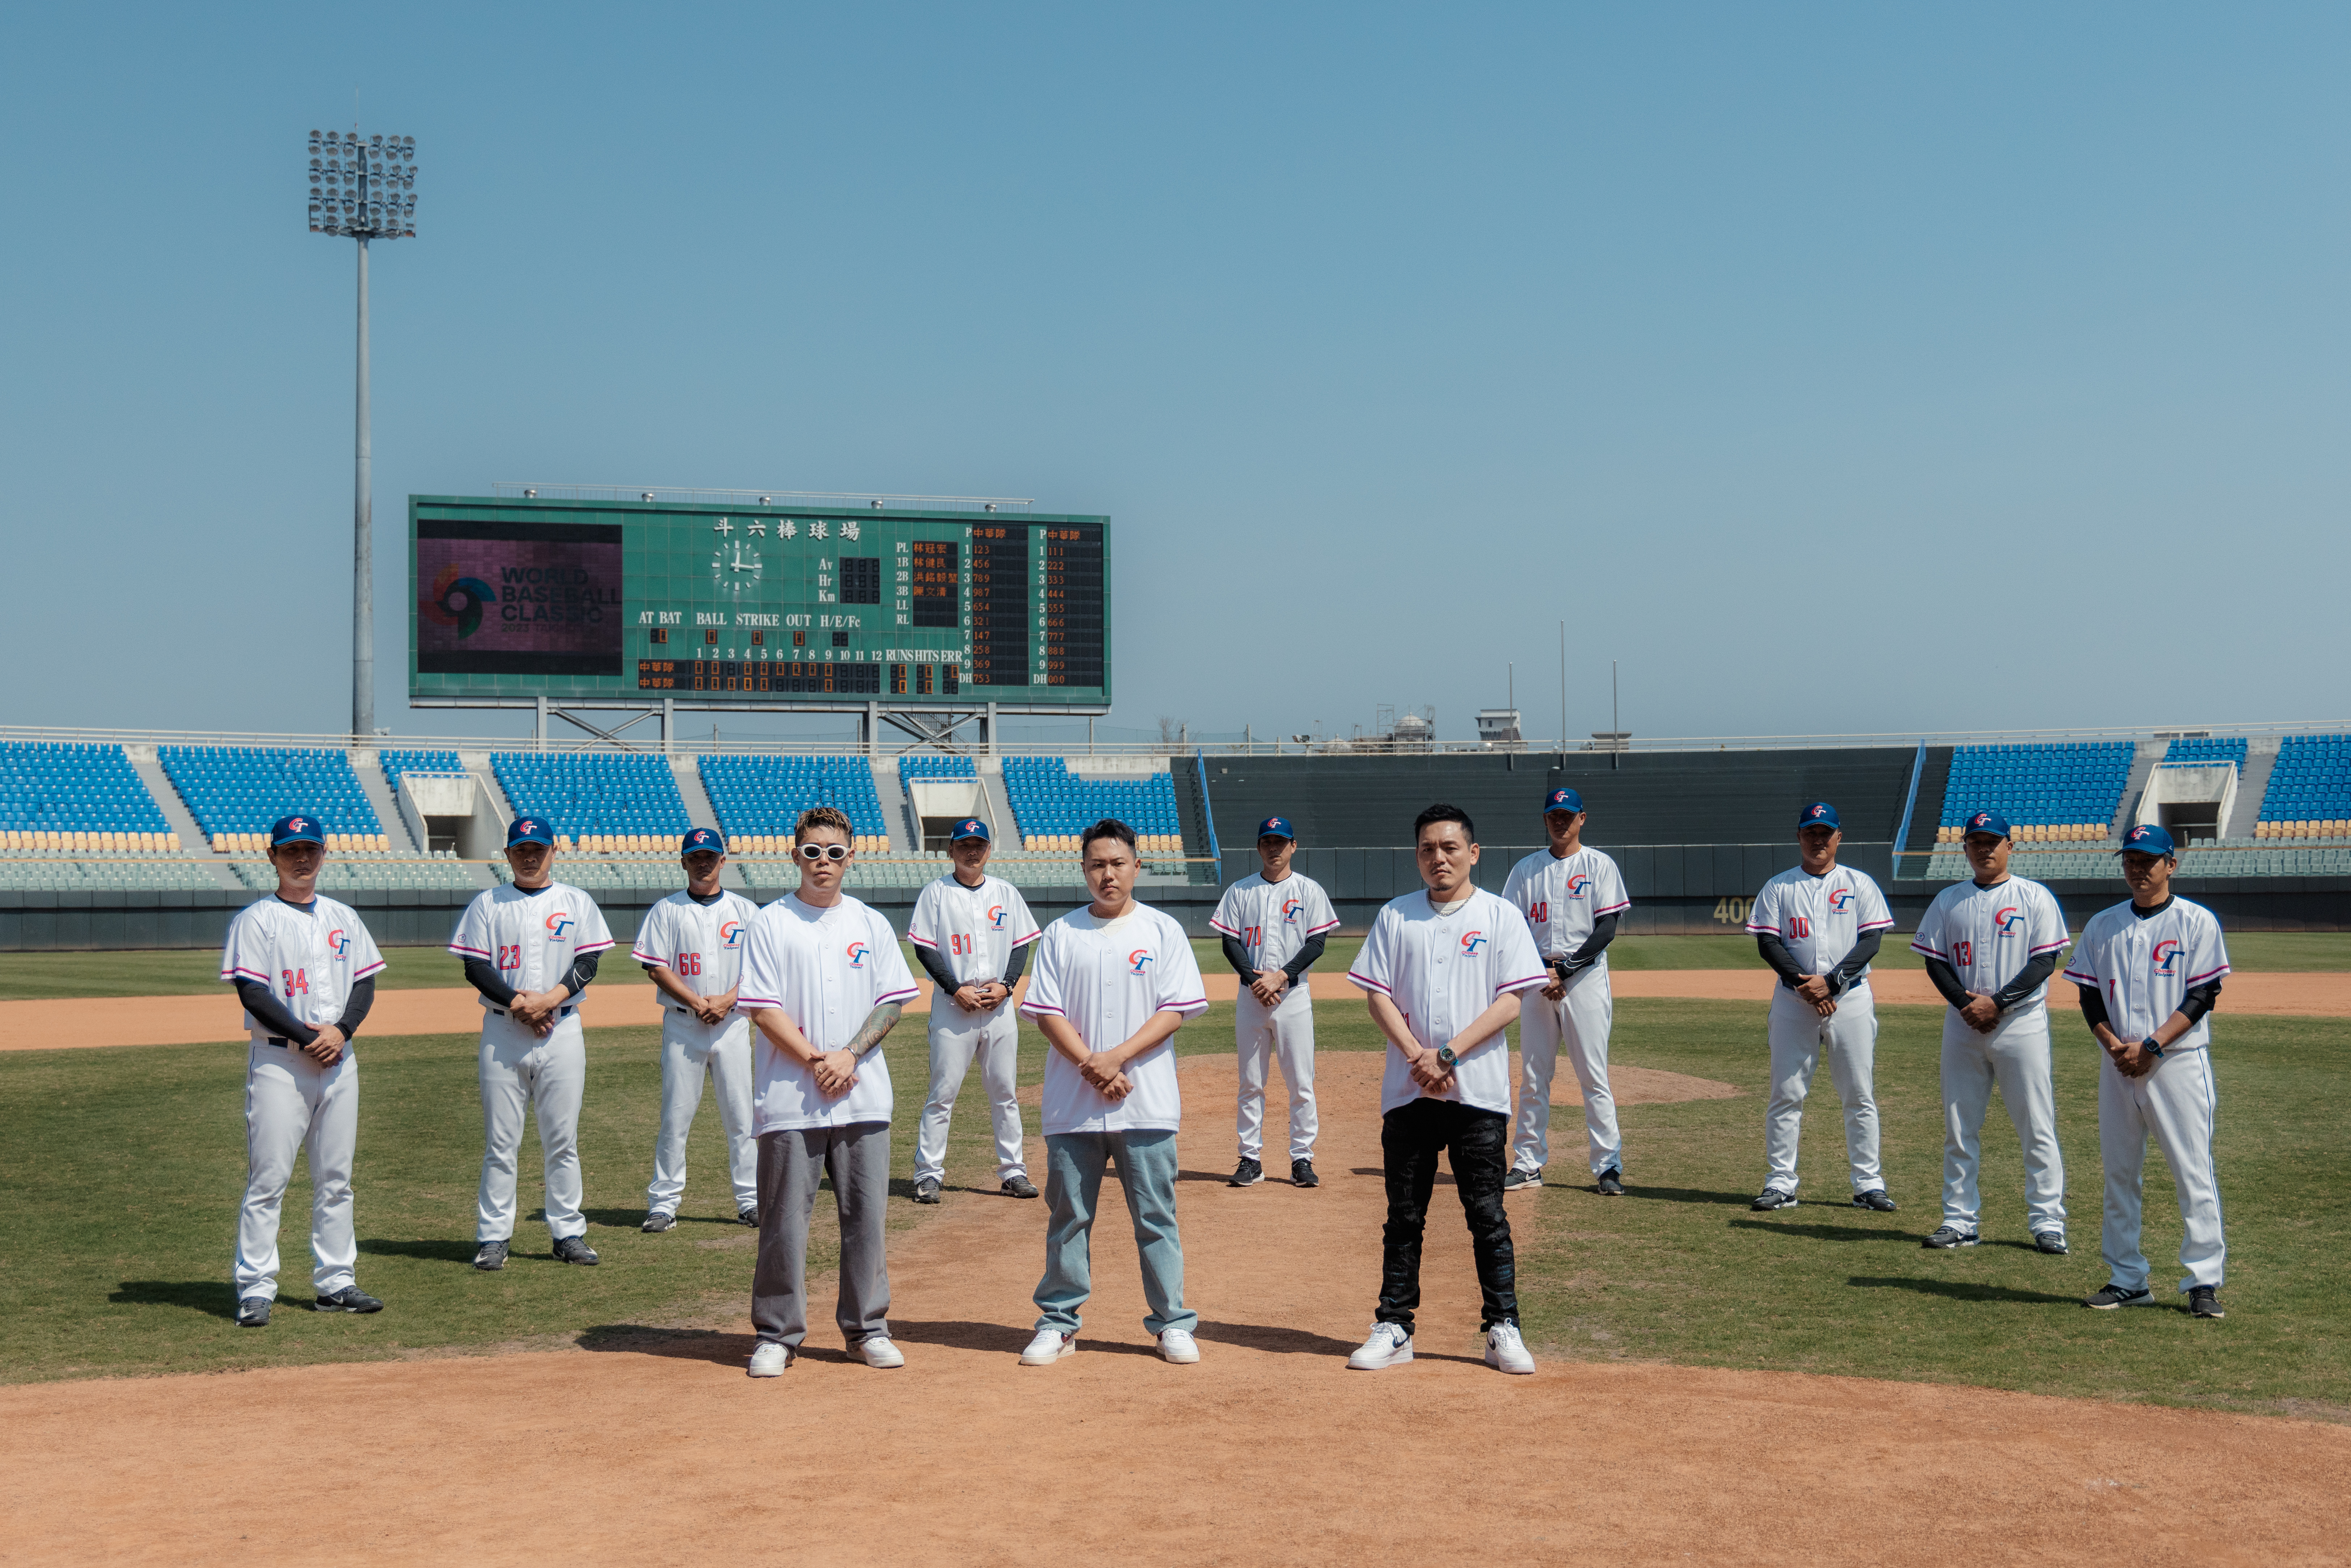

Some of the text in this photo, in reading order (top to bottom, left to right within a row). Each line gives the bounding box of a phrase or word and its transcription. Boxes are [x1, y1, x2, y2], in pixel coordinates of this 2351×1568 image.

[714, 517, 860, 541] 斗六棒球場
[965, 527, 972, 537] P
[973, 528, 1006, 539] 中華隊
[1039, 529, 1046, 539] P
[1048, 530, 1080, 541] 中華隊
[897, 542, 908, 553] PL
[965, 544, 969, 554] 1
[1039, 546, 1044, 556] 1
[818, 558, 833, 570] Av
[897, 557, 908, 567] 1B
[964, 558, 970, 568] 2
[1038, 560, 1045, 570] 2
[501, 567, 589, 584] WORLD
[818, 574, 832, 586] Hr
[897, 571, 908, 581] 2B
[964, 573, 970, 583] 3
[1039, 575, 1045, 584] 3
[502, 585, 622, 605] BASEBALL
[818, 590, 835, 602] Km
[897, 586, 908, 596] 3B
[963, 587, 970, 597] 4
[1038, 589, 1045, 598] 4
[897, 600, 908, 610] LL
[964, 601, 970, 611] 5
[1039, 603, 1045, 613] 5
[501, 604, 603, 623] CLASSIC
[639, 611, 682, 624] AT BAT
[696, 613, 727, 625] BALL
[736, 613, 780, 626] STRIKE
[897, 614, 909, 624] RL
[786, 614, 812, 627] OUT
[820, 615, 861, 627] H/E/Fc
[964, 616, 970, 626] 6
[1039, 617, 1045, 627] 6
[659, 629, 667, 643] 0
[708, 630, 716, 643] 0
[753, 631, 761, 644] 0
[795, 632, 804, 645] 0
[964, 630, 970, 640] 7
[1039, 631, 1045, 641] 7
[696, 648, 963, 662] 1 2 3 4 5 6 7 8 9 10 11 12 RUNS HITS ERR
[964, 644, 970, 654] 8
[1039, 645, 1045, 655] 8
[639, 662, 674, 673] 中華隊
[964, 659, 970, 669] 9
[1039, 660, 1046, 670] 9
[639, 677, 674, 688] 中華隊
[959, 673, 972, 683] DH
[1033, 674, 1047, 684] DH
[1554, 791, 1568, 803] CT
[1811, 805, 1826, 817] CT
[289, 818, 308, 833] CT
[1267, 818, 1281, 829] CT
[1974, 813, 1991, 826] CT
[520, 821, 537, 835] CT
[965, 821, 979, 832] CT
[694, 831, 709, 843] CT
[2131, 827, 2150, 840] CT
[1567, 874, 1591, 894] CT
[1829, 889, 1855, 909] CT
[1282, 899, 1303, 919] CT
[1530, 902, 1547, 923] 40
[988, 906, 1007, 925] CT
[1995, 907, 2024, 931] CT
[546, 912, 574, 936] CT
[720, 921, 744, 943] CT
[328, 929, 350, 954] CT
[951, 934, 972, 955] 91
[1461, 931, 1487, 952] CT
[500, 945, 520, 970] 23
[847, 942, 869, 963] CT
[1953, 941, 1972, 967] 13
[2152, 940, 2185, 969] CT
[679, 953, 701, 976] 66
[1129, 949, 1153, 970] CT
[282, 969, 309, 997] 34
